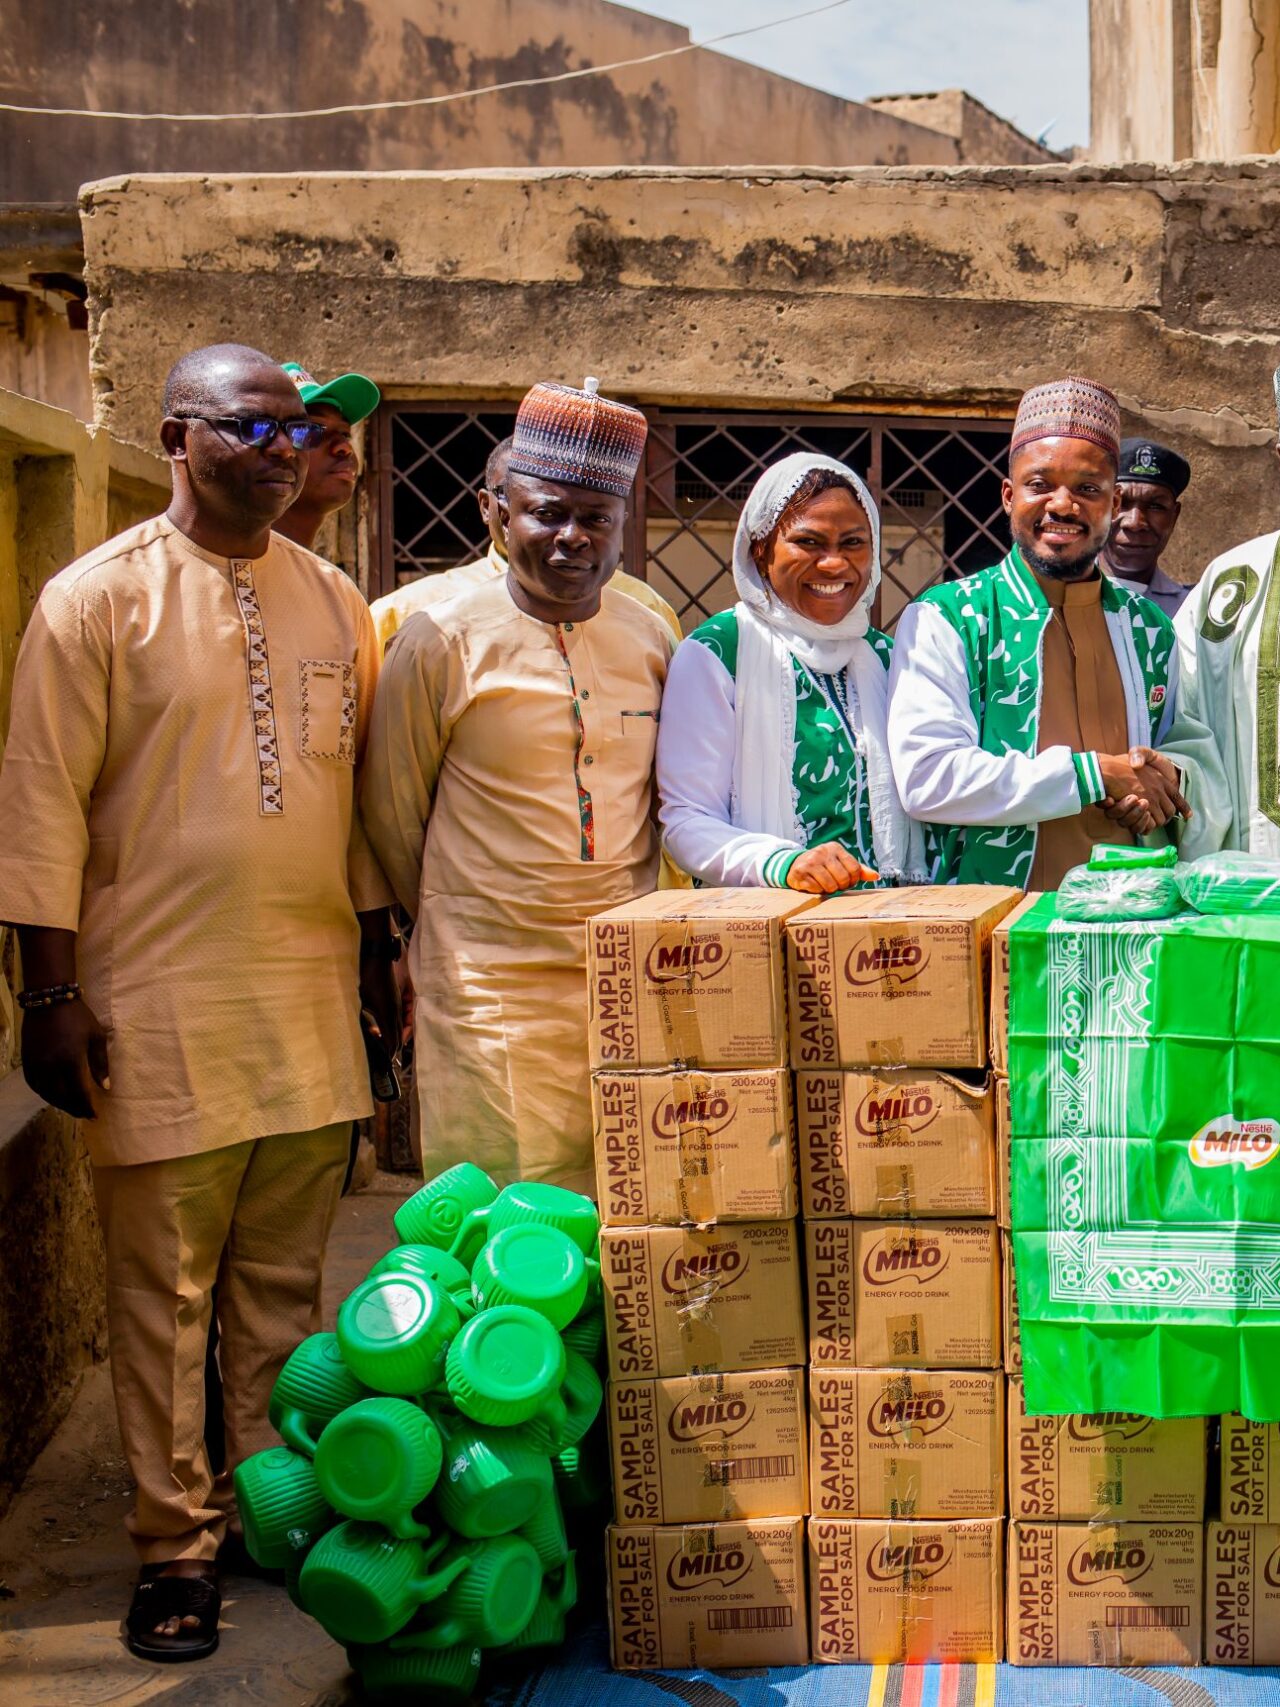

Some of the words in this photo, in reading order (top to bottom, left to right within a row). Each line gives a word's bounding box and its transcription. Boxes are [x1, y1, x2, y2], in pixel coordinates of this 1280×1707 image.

[725, 922, 770, 932] 200x20g
[925, 925, 970, 935] 200x20g
[616, 924, 630, 971] SALE
[655, 942, 724, 969] MILO
[816, 927, 830, 974] SALE
[855, 945, 923, 972] MILO
[596, 923, 622, 1060] SAMPLES
[619, 977, 633, 1015] FOR
[796, 927, 822, 1062] SAMPLES
[819, 980, 833, 1018] FOR
[622, 1025, 635, 1060] NOT
[822, 1027, 835, 1062] NOT
[732, 1077, 776, 1088] 200x20g
[623, 1081, 637, 1128] SALE
[662, 1098, 730, 1125] MILO
[827, 1078, 841, 1125] SALE
[865, 1095, 934, 1122] MILO
[603, 1081, 631, 1216] SAMPLES
[627, 1134, 641, 1171] FOR
[807, 1078, 833, 1213] SAMPLES
[830, 1131, 843, 1168] FOR
[1204, 1131, 1273, 1153] MILO
[630, 1181, 644, 1216] NOT
[833, 1177, 846, 1212] NOT
[743, 1227, 788, 1240] 200x20g
[836, 1227, 849, 1273] SALE
[944, 1227, 989, 1237] 200x20g
[631, 1238, 647, 1285] SALE
[672, 1250, 742, 1281] MILO
[874, 1246, 942, 1272] MILO
[610, 1238, 640, 1372] SAMPLES
[636, 1291, 650, 1328] FOR
[816, 1226, 838, 1360] SAMPLES
[838, 1279, 850, 1317] FOR
[640, 1337, 654, 1371] NOT
[839, 1326, 851, 1360] NOT
[749, 1379, 794, 1390] 200x20g
[840, 1379, 853, 1425] SALE
[638, 1387, 653, 1433] SALE
[678, 1400, 748, 1429] MILO
[879, 1399, 946, 1423] MILO
[618, 1387, 646, 1518] SAMPLES
[642, 1438, 656, 1474] FOR
[820, 1378, 842, 1511] SAMPLES
[842, 1431, 854, 1467] FOR
[1042, 1434, 1054, 1471] FOR
[1252, 1435, 1264, 1472] FOR
[645, 1483, 659, 1518] NOT
[842, 1477, 855, 1510] NOT
[1043, 1481, 1055, 1515] NOT
[1252, 1481, 1264, 1515] NOT
[839, 1524, 852, 1569] SALE
[1040, 1529, 1053, 1574] SALE
[1149, 1529, 1193, 1539] 200x20g
[637, 1535, 652, 1580] SALE
[677, 1551, 746, 1577] MILO
[877, 1543, 945, 1568] MILO
[1078, 1548, 1146, 1572] MILO
[1238, 1530, 1250, 1575] SALE
[617, 1535, 644, 1665] SAMPLES
[641, 1586, 655, 1622] FOR
[819, 1524, 842, 1654] SAMPLES
[841, 1575, 853, 1611] FOR
[1019, 1528, 1040, 1658] SAMPLES
[1041, 1580, 1053, 1616] FOR
[1216, 1529, 1237, 1659] SAMPLES
[1238, 1581, 1249, 1617] FOR
[644, 1631, 658, 1664] NOT
[842, 1620, 855, 1654] NOT
[1042, 1625, 1054, 1658] NOT
[1238, 1626, 1249, 1659] NOT
